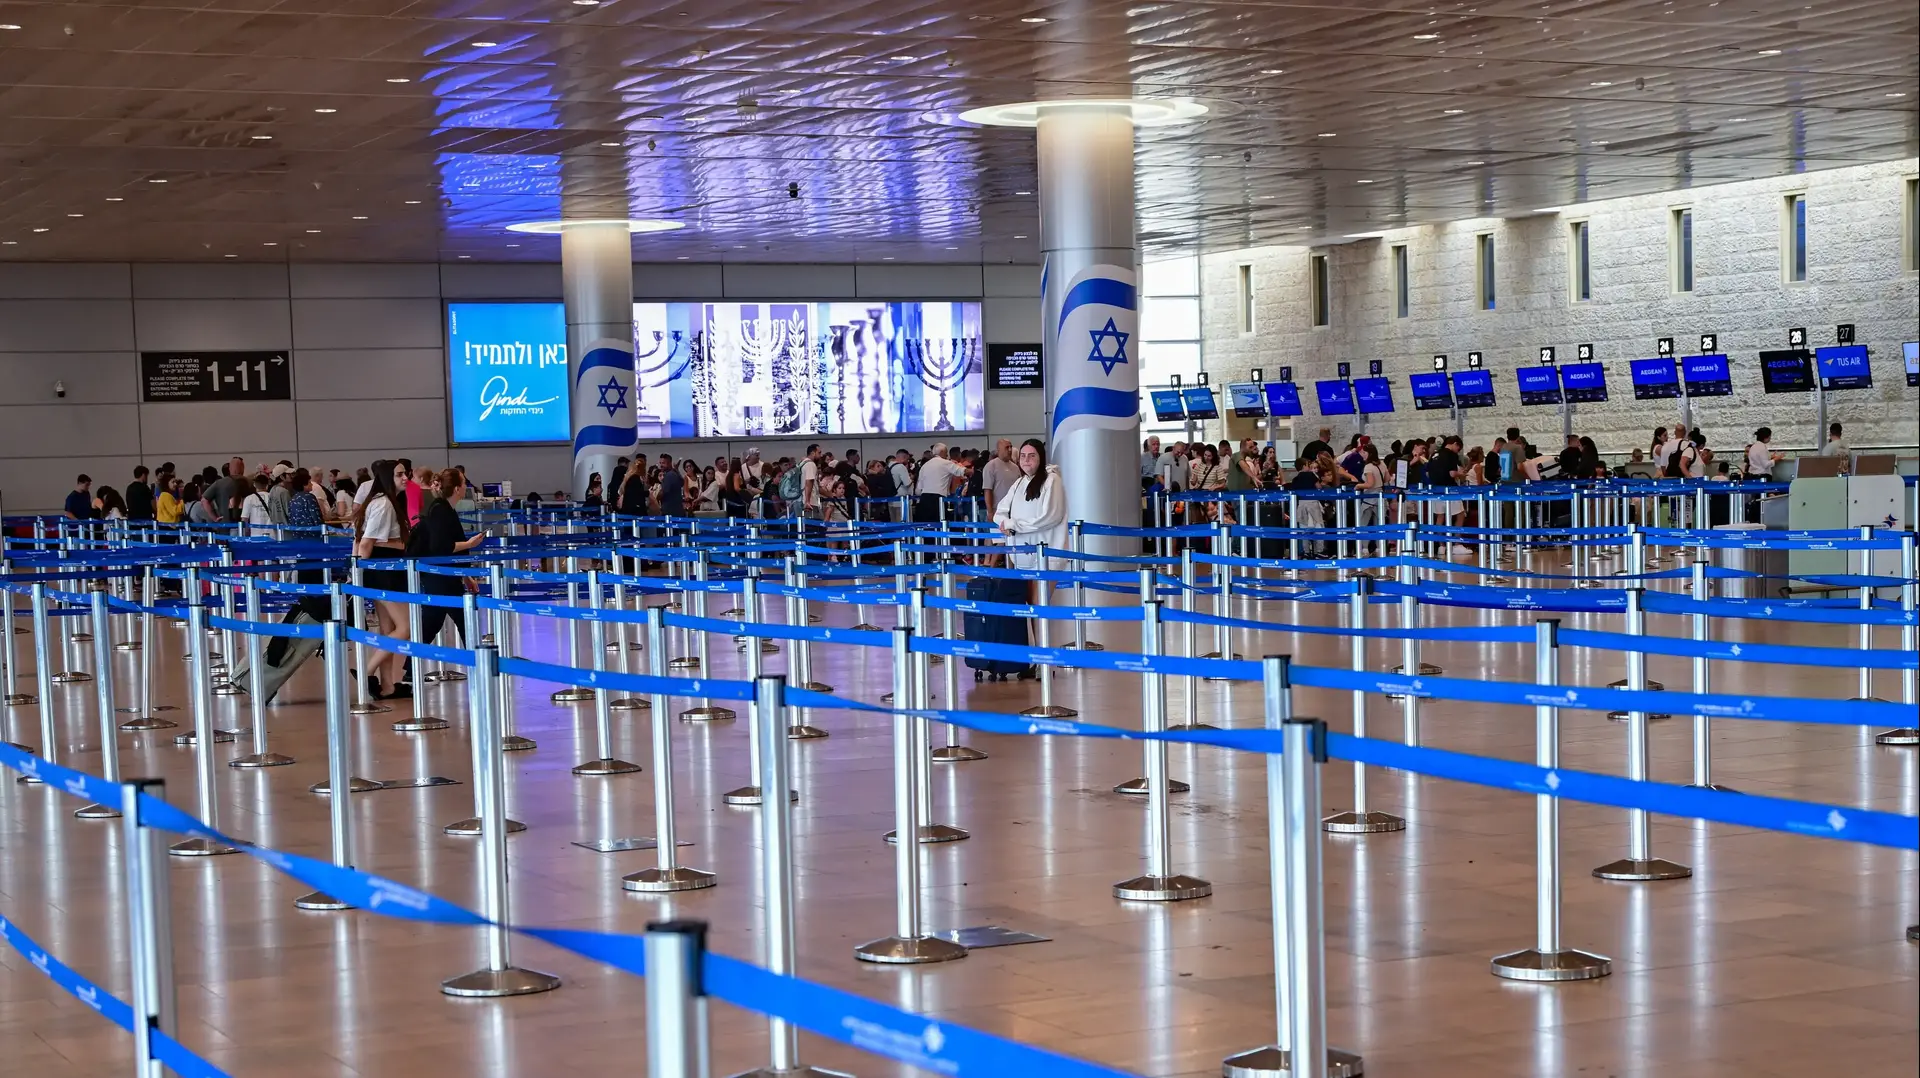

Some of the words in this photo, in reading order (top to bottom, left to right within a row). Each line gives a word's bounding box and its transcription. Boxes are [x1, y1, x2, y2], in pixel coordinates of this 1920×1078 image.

[1791, 331, 1802, 344] 26
[1839, 327, 1850, 339] 27
[1659, 341, 1670, 352] 24
[1702, 337, 1713, 348] 25
[464, 341, 532, 365] ולתמיד!
[539, 344, 568, 368] כאן
[1541, 350, 1551, 360] 22
[1580, 346, 1589, 358] 23
[1435, 358, 1444, 368] 20
[1470, 354, 1478, 366] 21
[1837, 357, 1850, 366] TUS
[1850, 356, 1861, 366] AIR
[207, 361, 266, 391] 1-11
